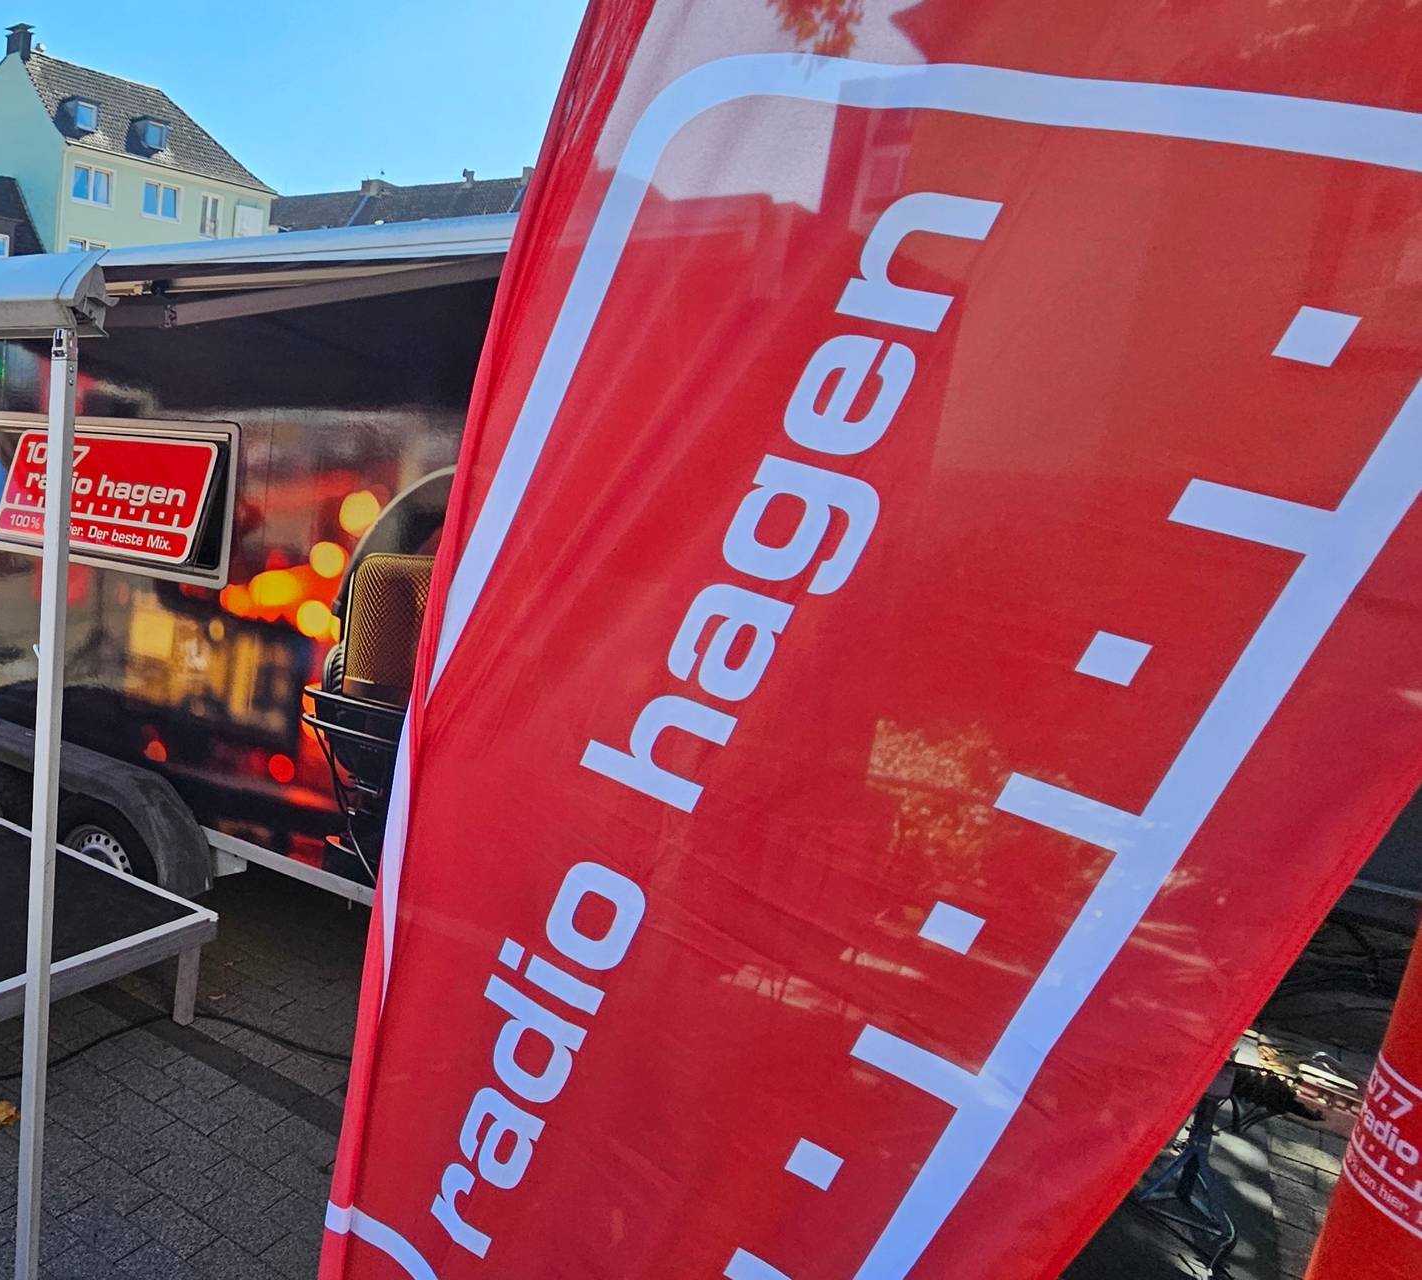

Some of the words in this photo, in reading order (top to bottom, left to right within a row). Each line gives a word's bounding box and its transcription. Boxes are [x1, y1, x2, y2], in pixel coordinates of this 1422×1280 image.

[25, 441, 91, 467] 107
[25, 471, 93, 496] raio
[97, 474, 187, 508] hagen
[69, 521, 85, 538] ier.
[87, 525, 110, 541] Der
[110, 527, 145, 548] beste
[145, 533, 172, 552] Mix.
[429, 859, 647, 1260] radio
[579, 190, 1003, 813] hagen
[1368, 1066, 1414, 1120] 07.7
